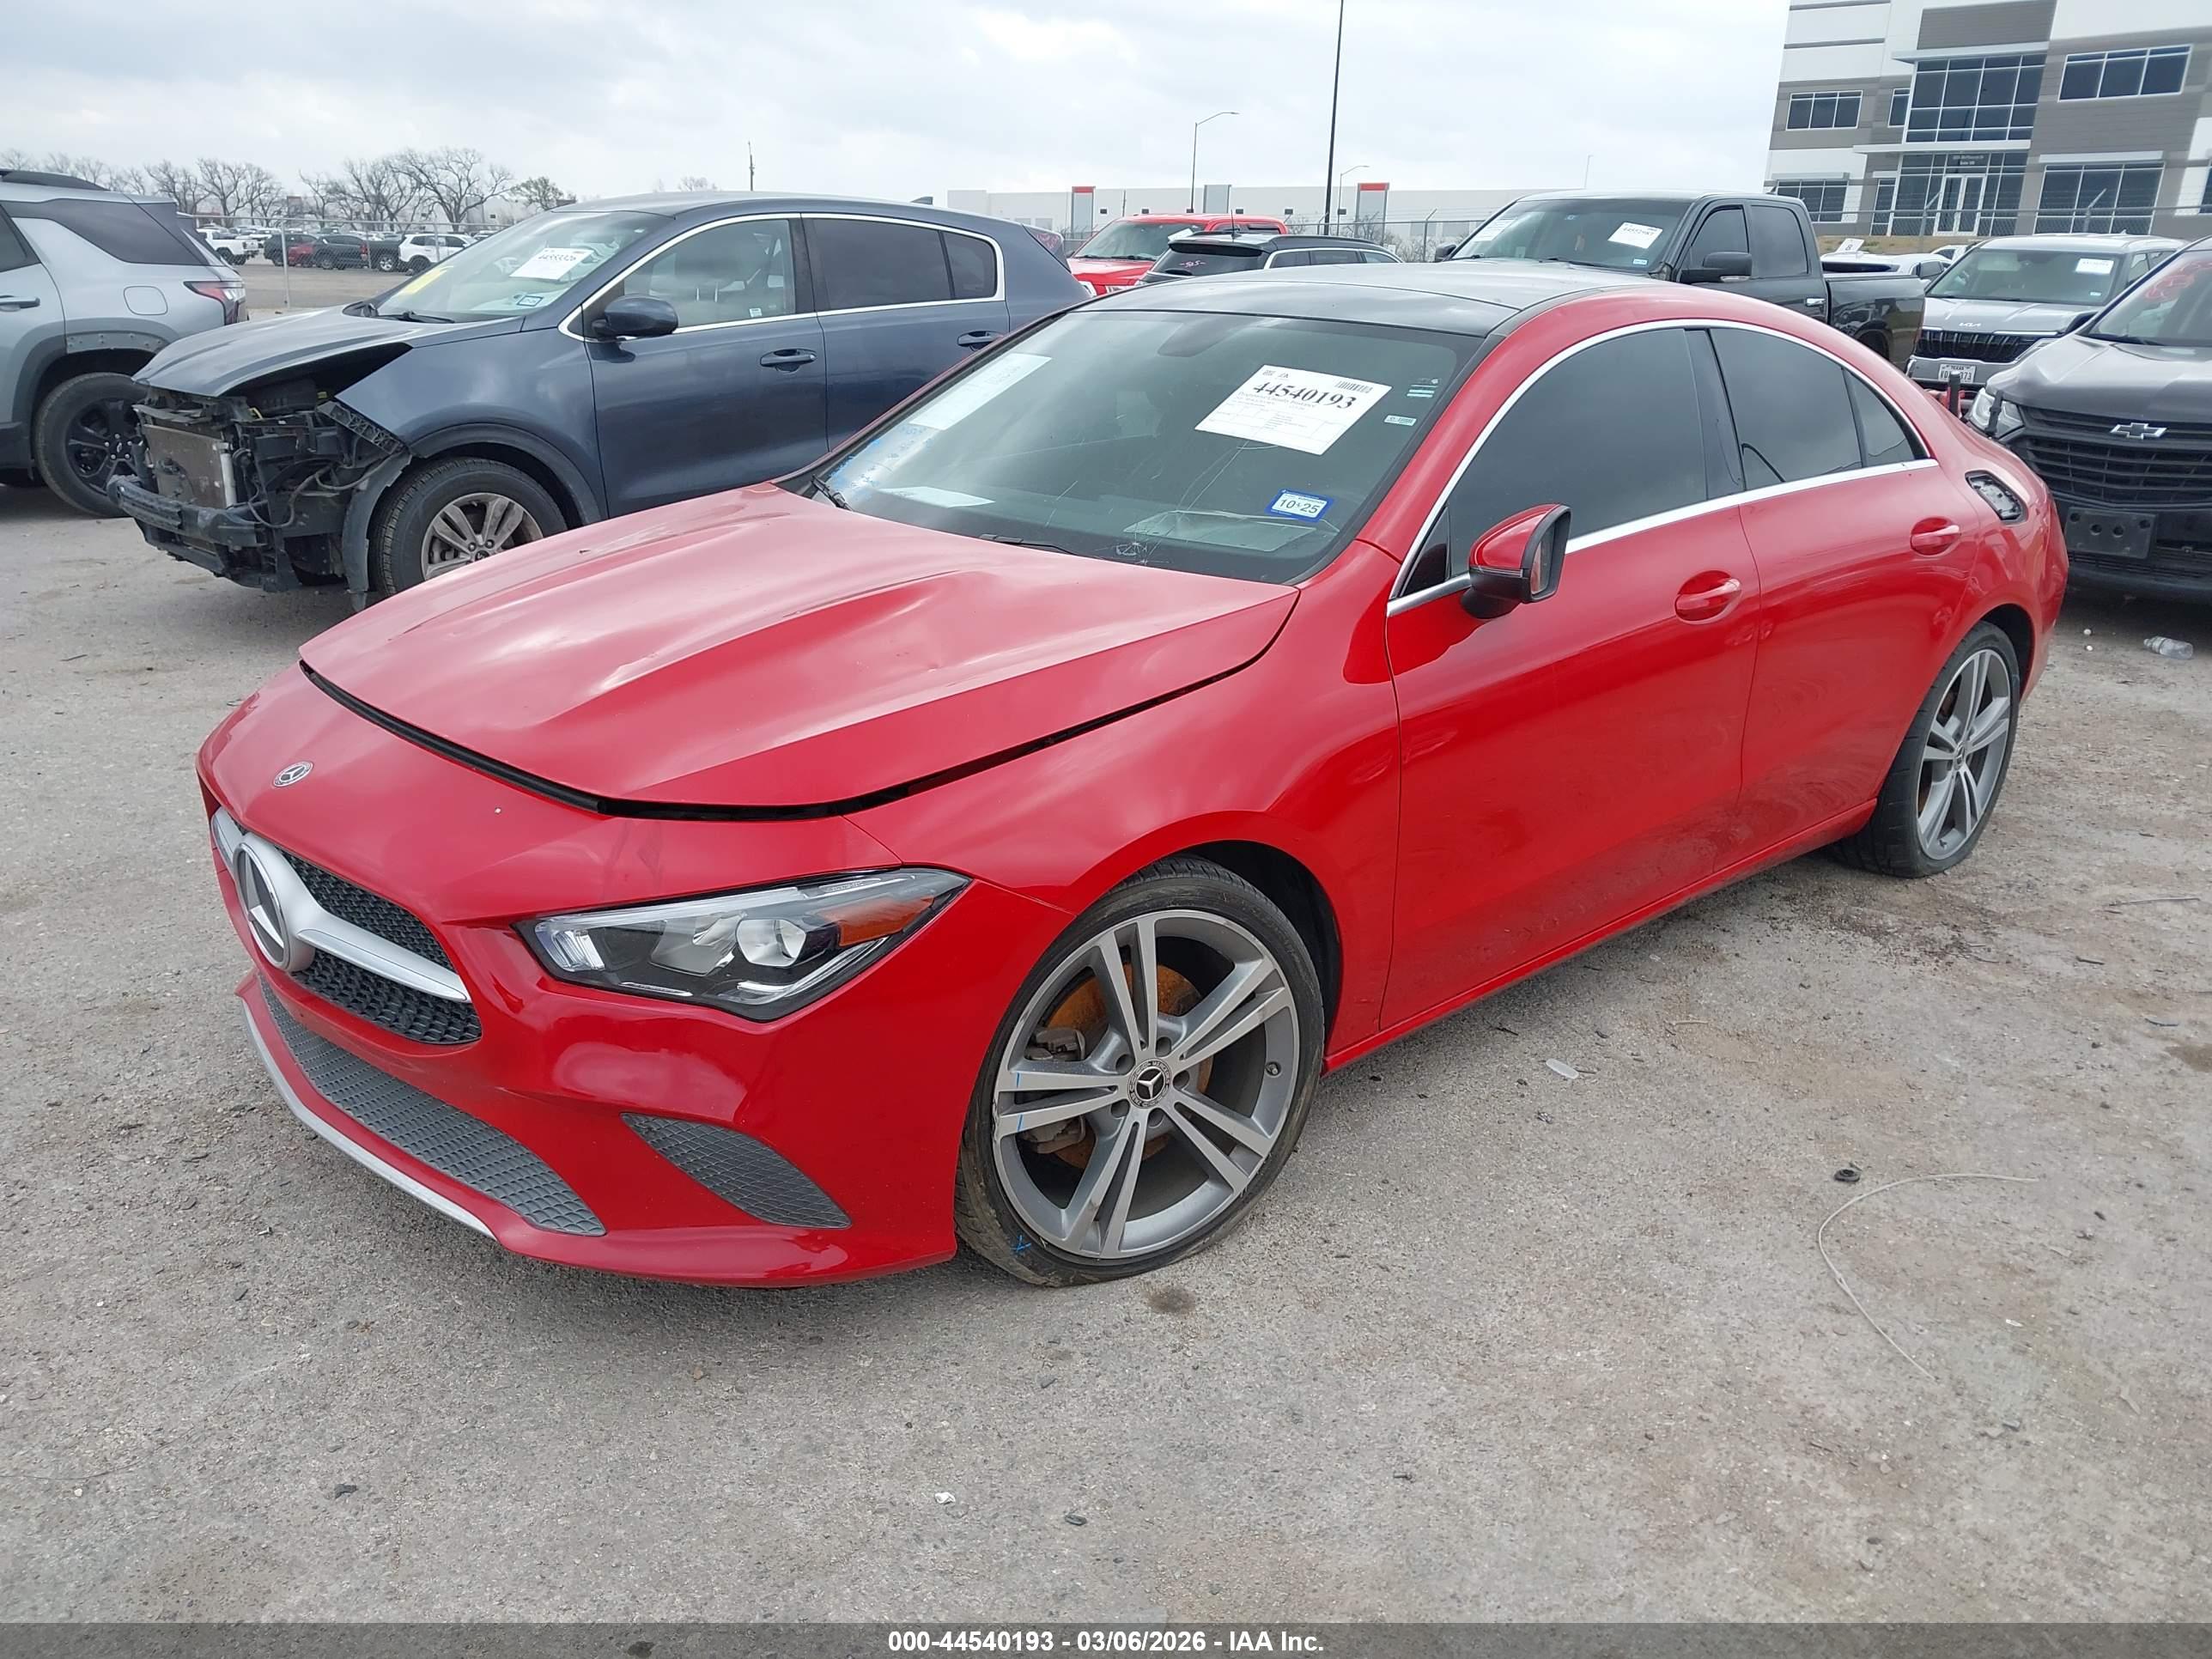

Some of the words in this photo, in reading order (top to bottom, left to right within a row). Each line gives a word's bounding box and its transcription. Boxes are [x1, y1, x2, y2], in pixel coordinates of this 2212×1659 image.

[1253, 381, 1357, 410] 44540193
[1279, 499, 1297, 508] 10
[1300, 503, 1321, 514] 25
